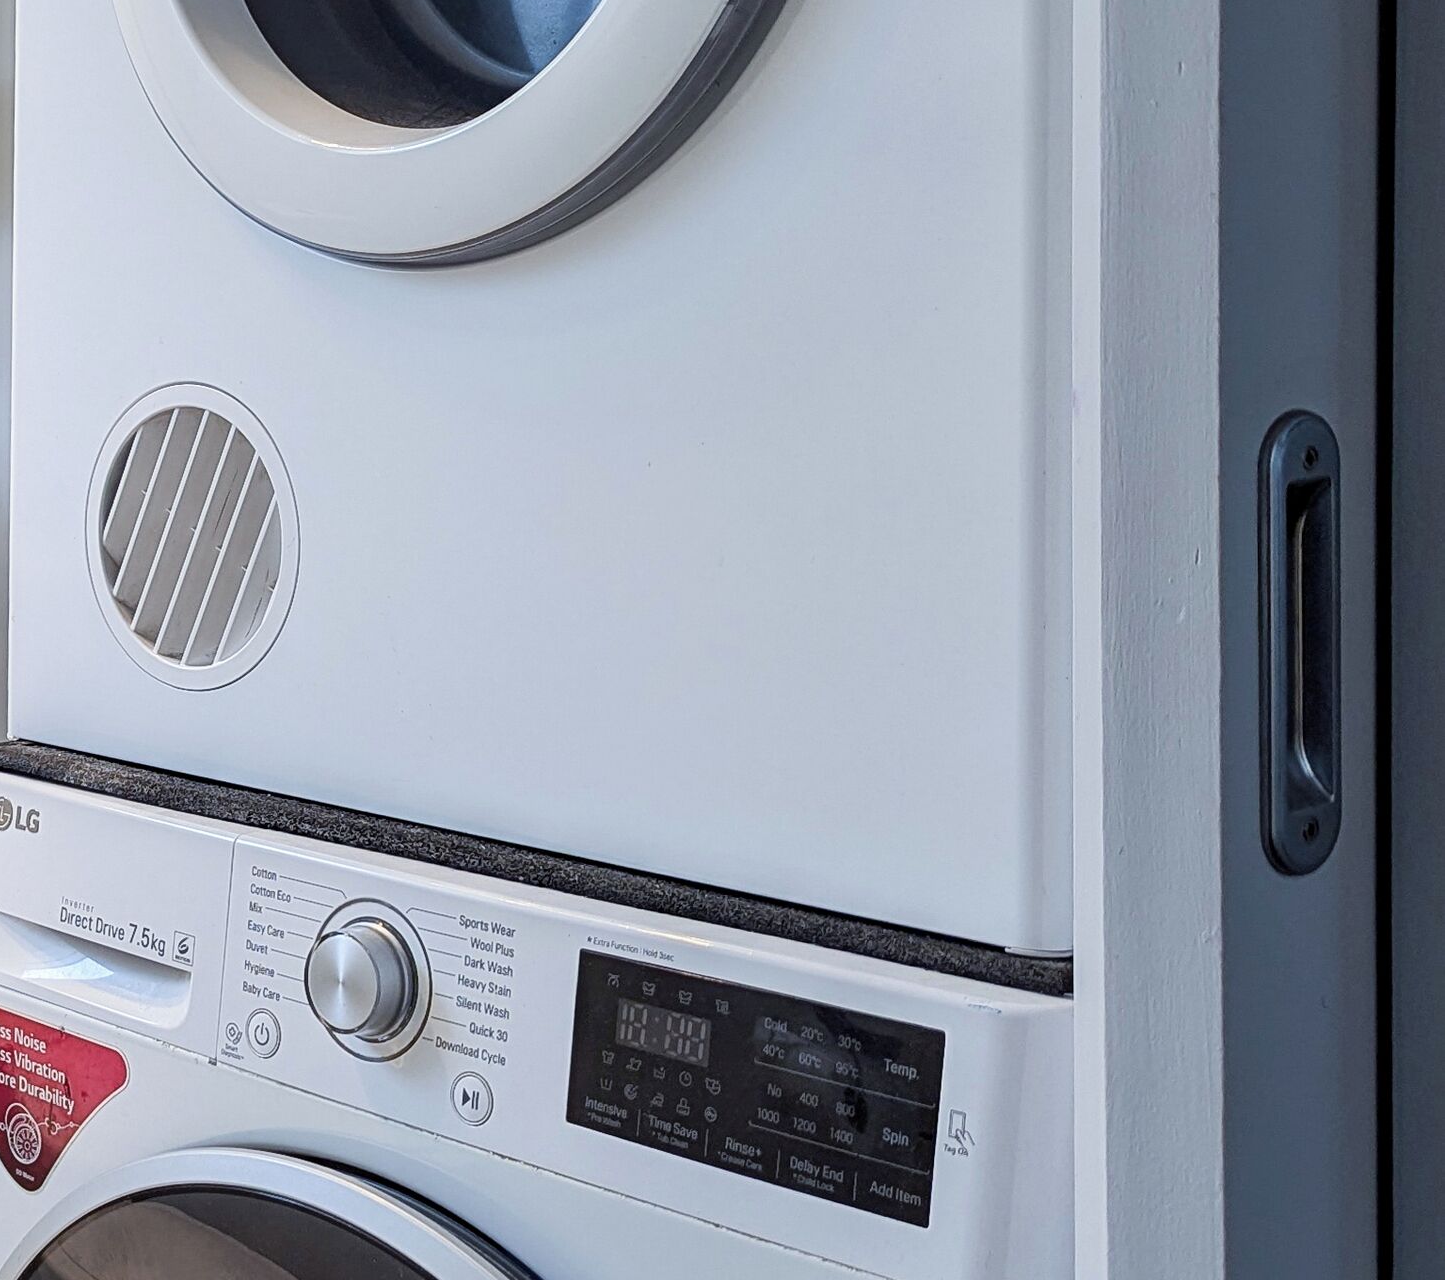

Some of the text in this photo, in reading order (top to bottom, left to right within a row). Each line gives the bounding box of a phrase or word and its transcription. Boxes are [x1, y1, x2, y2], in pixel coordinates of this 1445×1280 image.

[15, 806, 41, 834] LG
[251, 865, 277, 881] Cotton
[61, 896, 95, 913] Inverter
[250, 883, 291, 903] Cotton Eco
[249, 901, 263, 914] Mix
[60, 906, 166, 957] Direct Drive 7.5kg
[248, 920, 285, 939] Easy Care
[459, 914, 516, 938] Sports Wear
[246, 939, 268, 955] Duvet
[470, 936, 515, 958] Wool Plus
[244, 960, 275, 978] Hygiene
[464, 955, 513, 978] Dark Wash
[242, 980, 281, 1002] Baby Care
[457, 974, 512, 999] Heavy Stain
[455, 995, 510, 1020] Silent Wash
[469, 1022, 508, 1042] Quick 30
[764, 1016, 788, 1033] Cold
[14, 1030, 47, 1054] Noise
[435, 1036, 506, 1066] Download Cycle
[13, 1049, 66, 1085] Vibration
[884, 1058, 920, 1081] Temp.
[18, 1077, 75, 1116] Durability
[585, 1096, 628, 1119] Intensive
[767, 1083, 856, 1118] No 400 800
[649, 1114, 699, 1141] Time Save
[757, 1107, 854, 1145] 1000 1200 1400
[882, 1126, 909, 1147] Spin
[725, 1136, 762, 1157] Rinse+
[789, 1155, 844, 1183] Delay End
[870, 1180, 922, 1207] Add Item
